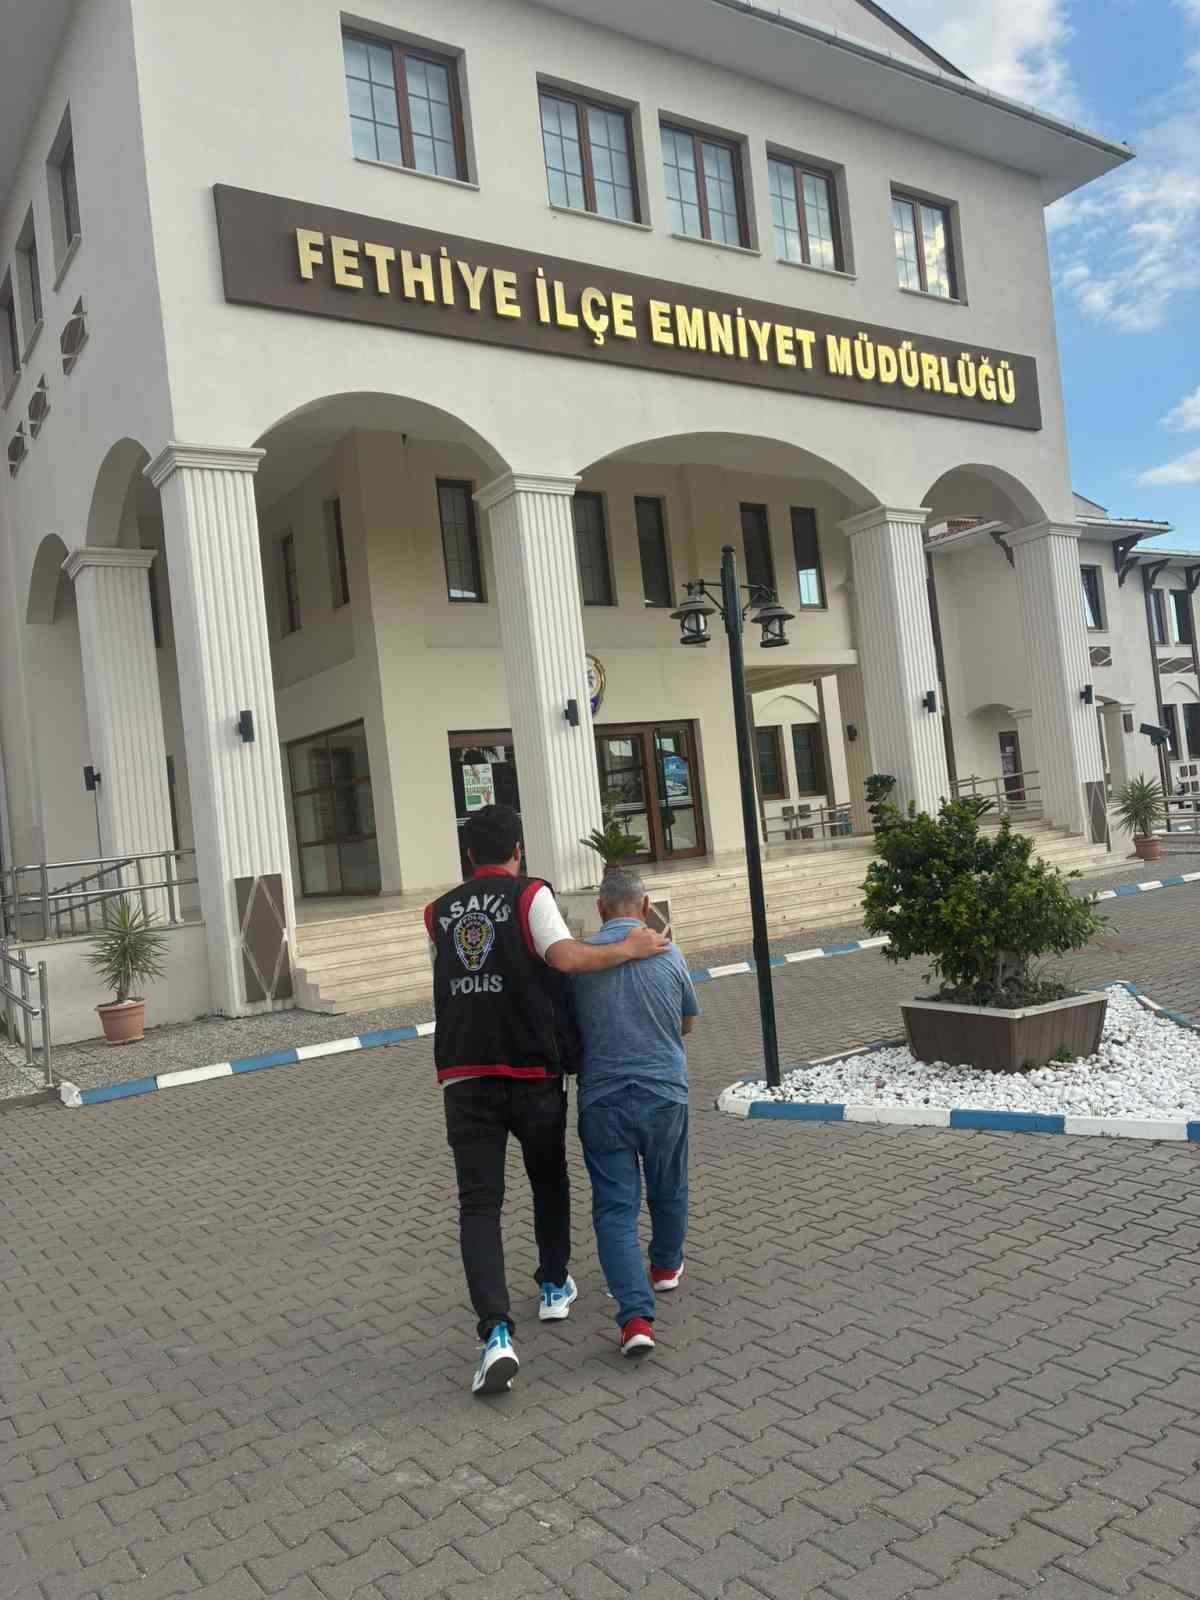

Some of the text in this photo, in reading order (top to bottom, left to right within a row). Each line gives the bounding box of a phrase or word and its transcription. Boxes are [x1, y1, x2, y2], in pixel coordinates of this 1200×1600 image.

[295, 227, 1016, 404] FETHİYE İLÇE EMNİYET MÜDÜRLÜĞÜ
